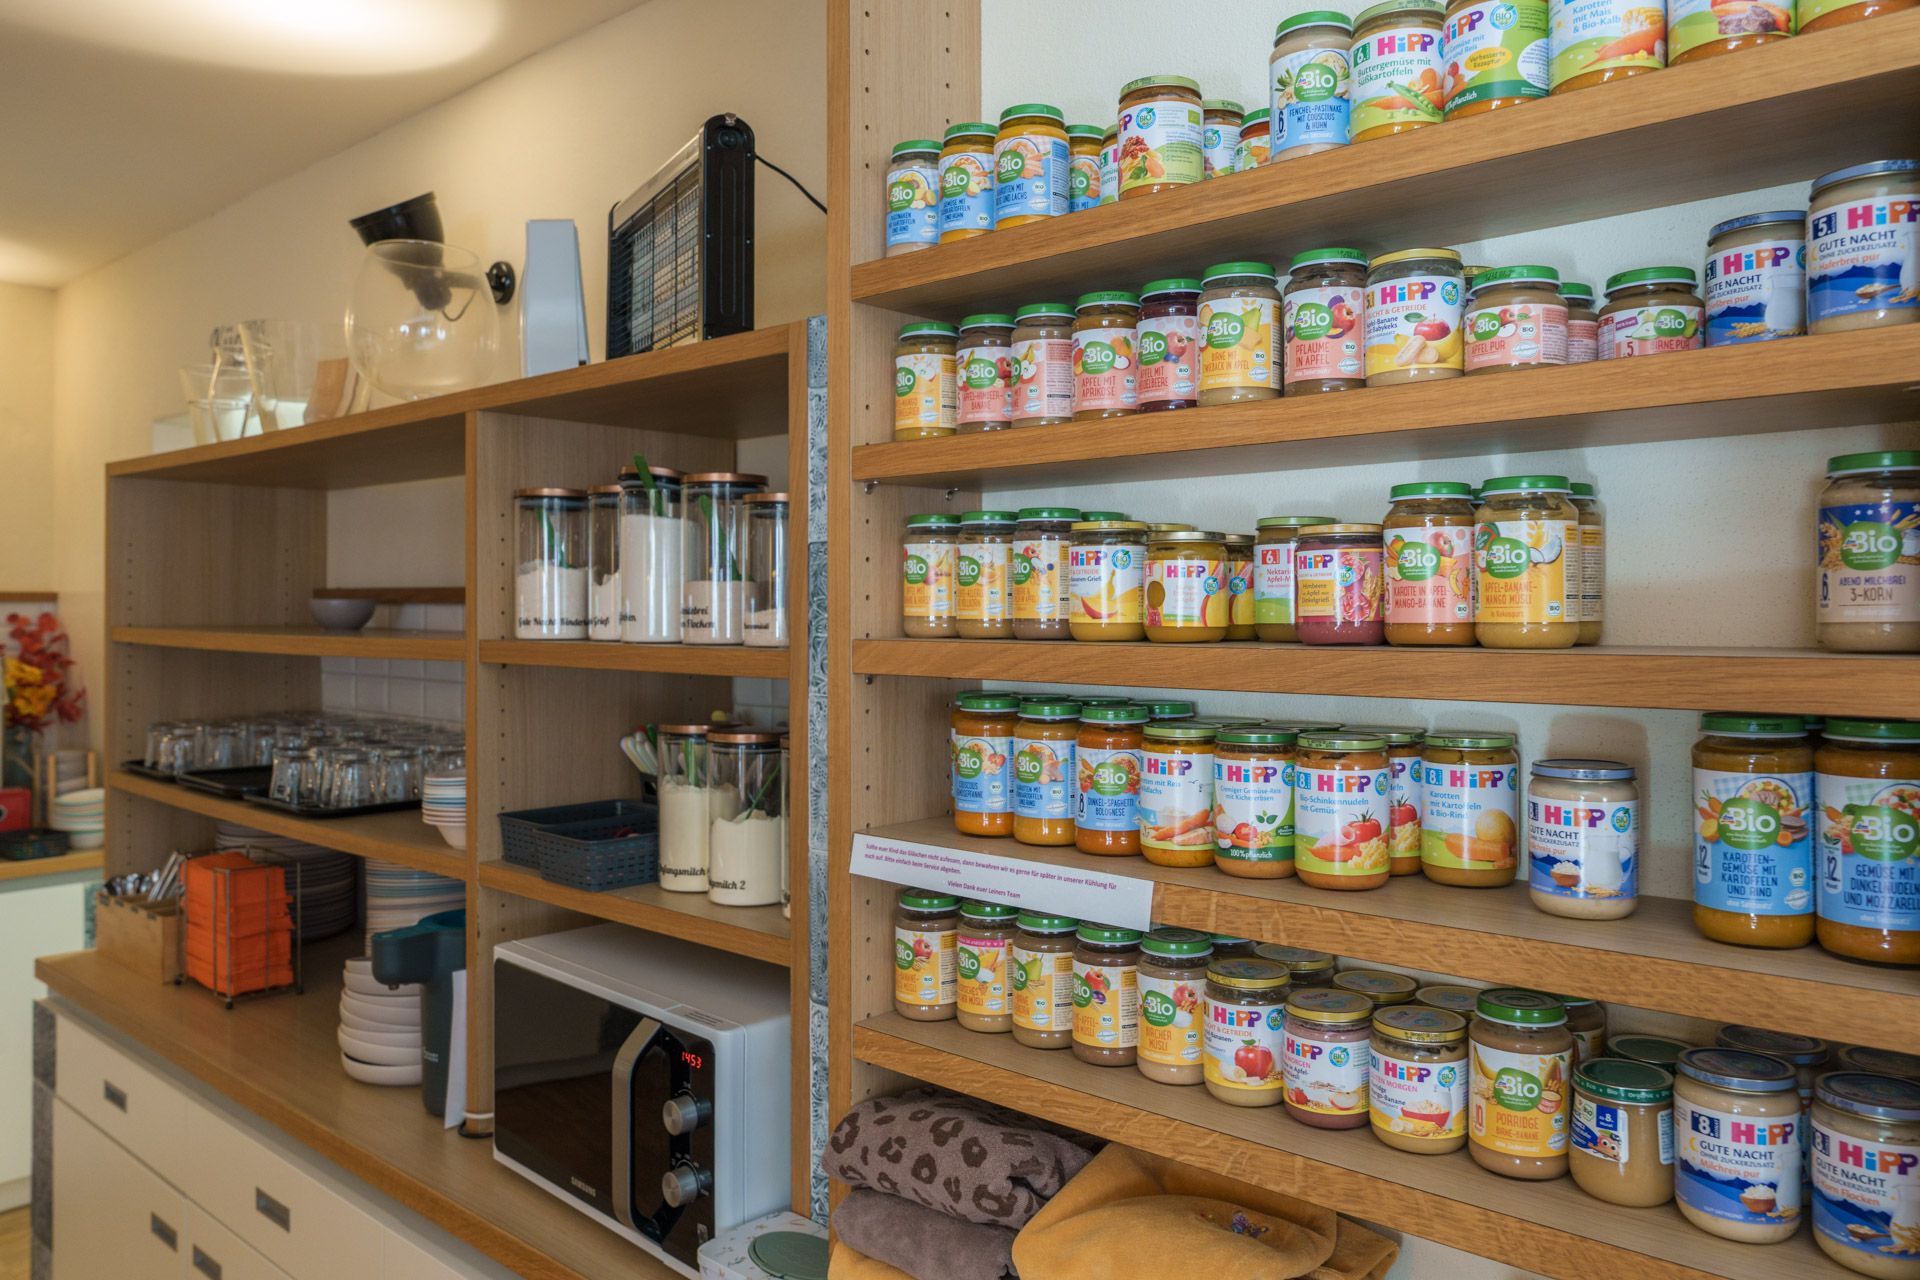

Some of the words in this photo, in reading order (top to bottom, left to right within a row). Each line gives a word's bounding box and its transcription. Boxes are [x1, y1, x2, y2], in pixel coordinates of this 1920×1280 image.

[1573, 14, 1588, 25] mit
[1589, 8, 1612, 21] Mais
[1582, 16, 1622, 32] Bio-Kalb
[1444, 10, 1484, 45] HiPP
[1377, 34, 1435, 58] HiPP
[1357, 60, 1415, 78] Buttergemüse
[1416, 57, 1431, 67] mit
[1301, 71, 1334, 89] Bio
[1358, 69, 1414, 87] Süßkartoffeln
[1290, 104, 1343, 119] FENCHEL-PASTINAKE
[1306, 111, 1335, 122] COUSCOUS
[1311, 120, 1329, 130] HUHN
[1847, 200, 1920, 231] HiPP
[1820, 239, 1846, 253] GUTE
[1850, 230, 1897, 245] NACHT
[1838, 241, 1897, 257] ZUCKERZUSATZ
[1723, 247, 1791, 276] HiPP
[1380, 281, 1437, 305] HiPP
[1707, 281, 1723, 296] GUTE
[1724, 275, 1762, 289] NACHT
[1391, 303, 1427, 314] GETREIDE
[1213, 318, 1241, 337] Bio
[1300, 309, 1330, 328] Bio
[1476, 317, 1499, 334] Bio
[1661, 315, 1685, 330] Bio
[1087, 346, 1113, 364] Bio
[1141, 338, 1165, 355] Bio
[1296, 342, 1330, 355] PFLAUME
[1472, 342, 1489, 354] APFEL
[1490, 339, 1506, 351] PUR
[1296, 357, 1303, 368] IN
[1305, 354, 1330, 367] APFEL
[973, 364, 996, 380] Bio
[1082, 385, 1116, 398] APRIKOSE
[1852, 529, 1898, 553] Bio
[1071, 550, 1107, 567] HiPP
[1299, 554, 1334, 570] HiPP
[1405, 548, 1437, 567] Bio
[1492, 544, 1528, 564] Bio
[1166, 565, 1206, 579] HiPP
[1839, 575, 1861, 587] ABEND
[1864, 575, 1907, 587] MILCHBREI
[1850, 587, 1893, 602] 3-KORN
[959, 752, 980, 770] Bio
[1018, 758, 1041, 775] Bio
[1147, 757, 1193, 777] HiPP
[1101, 767, 1128, 786] Bio
[1227, 765, 1278, 784] HiPP
[1317, 774, 1371, 793] HiPP
[1450, 769, 1503, 789] HiPP
[1154, 780, 1166, 788] mit
[1430, 790, 1460, 801] Karotten
[1095, 806, 1126, 817] BOLOGNESE
[1430, 800, 1441, 809] mit
[1442, 801, 1482, 812] Kartoffeln
[1544, 804, 1605, 828] HiPP
[1732, 806, 1776, 834] Bio
[1545, 828, 1580, 842] NACHT
[1864, 814, 1914, 843] Bio
[1538, 836, 1580, 849] ZUCKERZUSATZ
[896, 858, 912, 866] einfach
[912, 860, 923, 868] beim
[924, 863, 940, 871] Service
[1723, 851, 1776, 865] KAROTTEN-
[908, 850, 928, 859] Gläschen
[976, 860, 1000, 871] bewahren
[1016, 869, 1031, 877] gerne
[1031, 870, 1040, 878] für
[1040, 872, 1057, 882] später
[1064, 876, 1085, 885] unserer
[1085, 879, 1108, 890] Kühlung
[1108, 882, 1118, 890] für
[1721, 861, 1759, 876] GEMÜSE
[1762, 865, 1777, 876] MIT
[1855, 863, 1896, 879] GEMÜSE
[1898, 867, 1915, 880] MIT
[739, 880, 746, 890] 2
[1721, 873, 1779, 887] KARTOFFELN
[948, 880, 963, 888] Vielen
[963, 882, 976, 891] Dank
[1007, 890, 1021, 899] Team
[1727, 884, 1746, 897] UND
[1750, 886, 1773, 898] RIND
[1843, 891, 1863, 906] UND
[1147, 995, 1174, 1016] Bio
[1213, 1005, 1262, 1028] HiPP
[1286, 1036, 1323, 1061] HiPP
[681, 1051, 702, 1069] 1453
[1384, 1059, 1432, 1084] HiPP
[1386, 1078, 1418, 1094] MORGEN
[1502, 1072, 1539, 1099] Bio
[1496, 1111, 1539, 1128] PORRIDGE
[1731, 1120, 1794, 1147] HiPP
[1700, 1139, 1730, 1157] GUTE
[1733, 1147, 1775, 1161] NACHT
[1838, 1140, 1919, 1177] HiPP
[1701, 1157, 1742, 1176] Milchreis
[1743, 1167, 1761, 1180] pur
[1720, 1154, 1776, 1169] ZUCKERZUSATZ
[1816, 1156, 1838, 1176] GUTE
[1840, 1167, 1886, 1189] NACHT
[1830, 1174, 1888, 1198] ZUCKERZUSATZ
